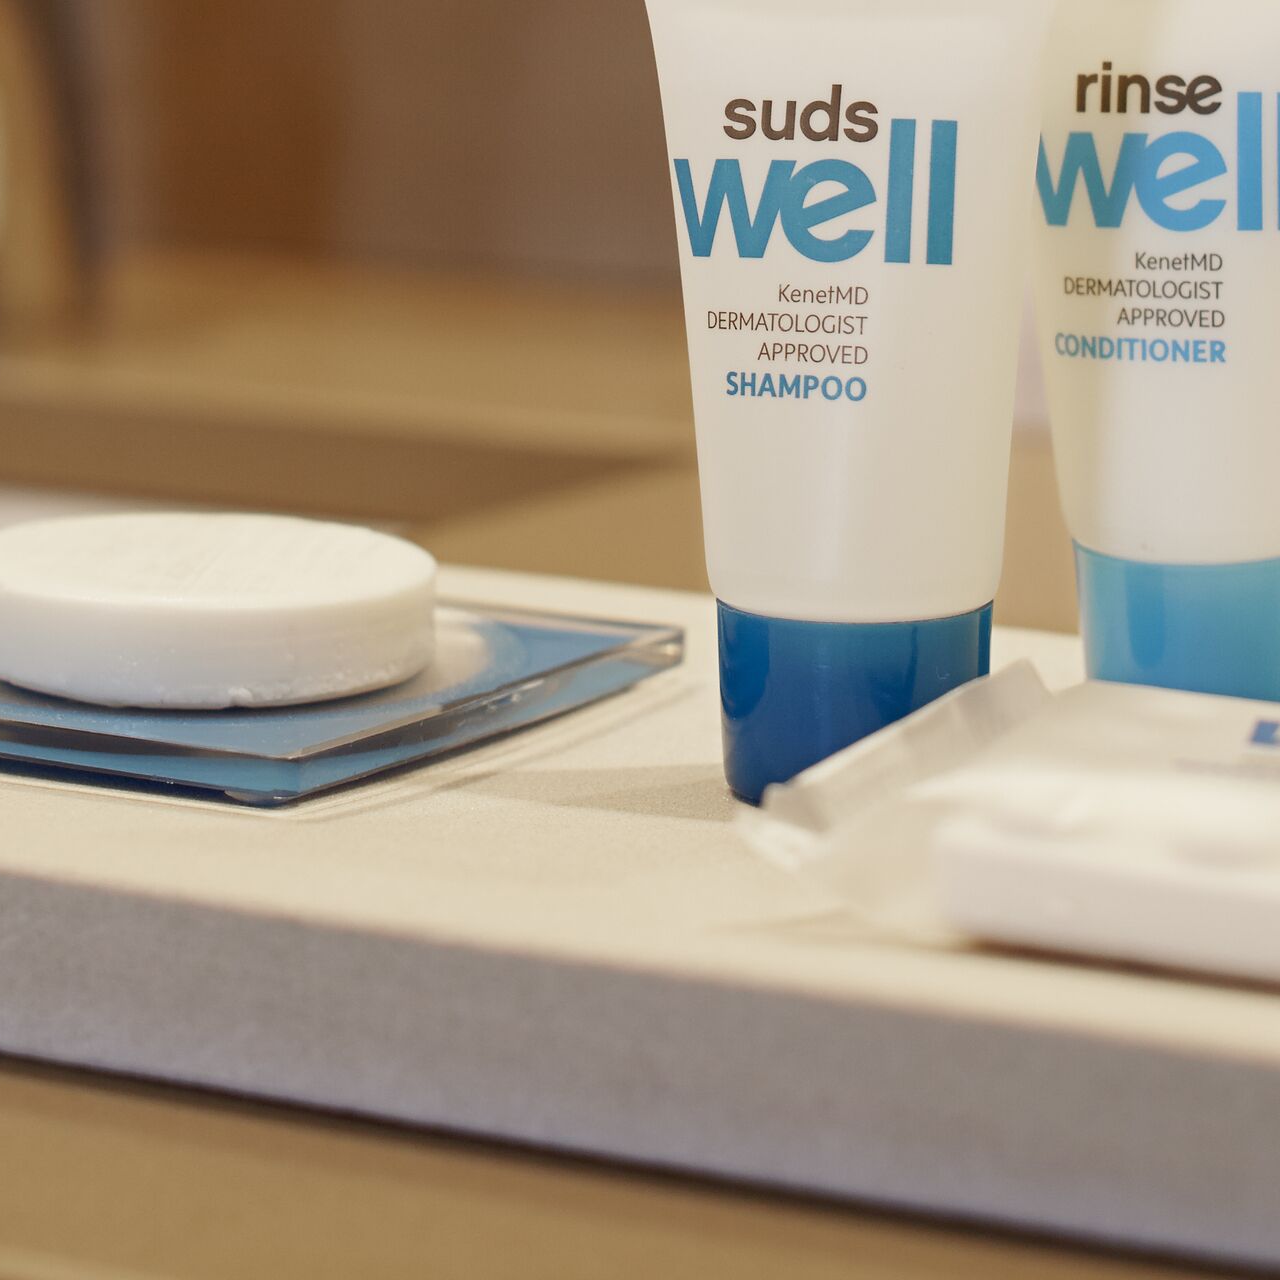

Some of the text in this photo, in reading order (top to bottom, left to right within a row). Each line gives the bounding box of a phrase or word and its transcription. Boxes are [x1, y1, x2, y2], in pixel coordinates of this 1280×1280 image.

[1075, 61, 1223, 116] rinse
[722, 84, 879, 142] suds
[673, 117, 958, 265] well
[1134, 251, 1223, 272] KenetMD
[777, 283, 869, 306] KenetMD
[1063, 276, 1223, 301] DERMATOLOGIST
[706, 311, 868, 336] DERMATOLOGIST
[1116, 307, 1226, 329] APPROVED
[757, 342, 869, 365] APPROVED
[1054, 332, 1227, 364] CONDITIONER
[725, 371, 867, 402] SHAMPOO
